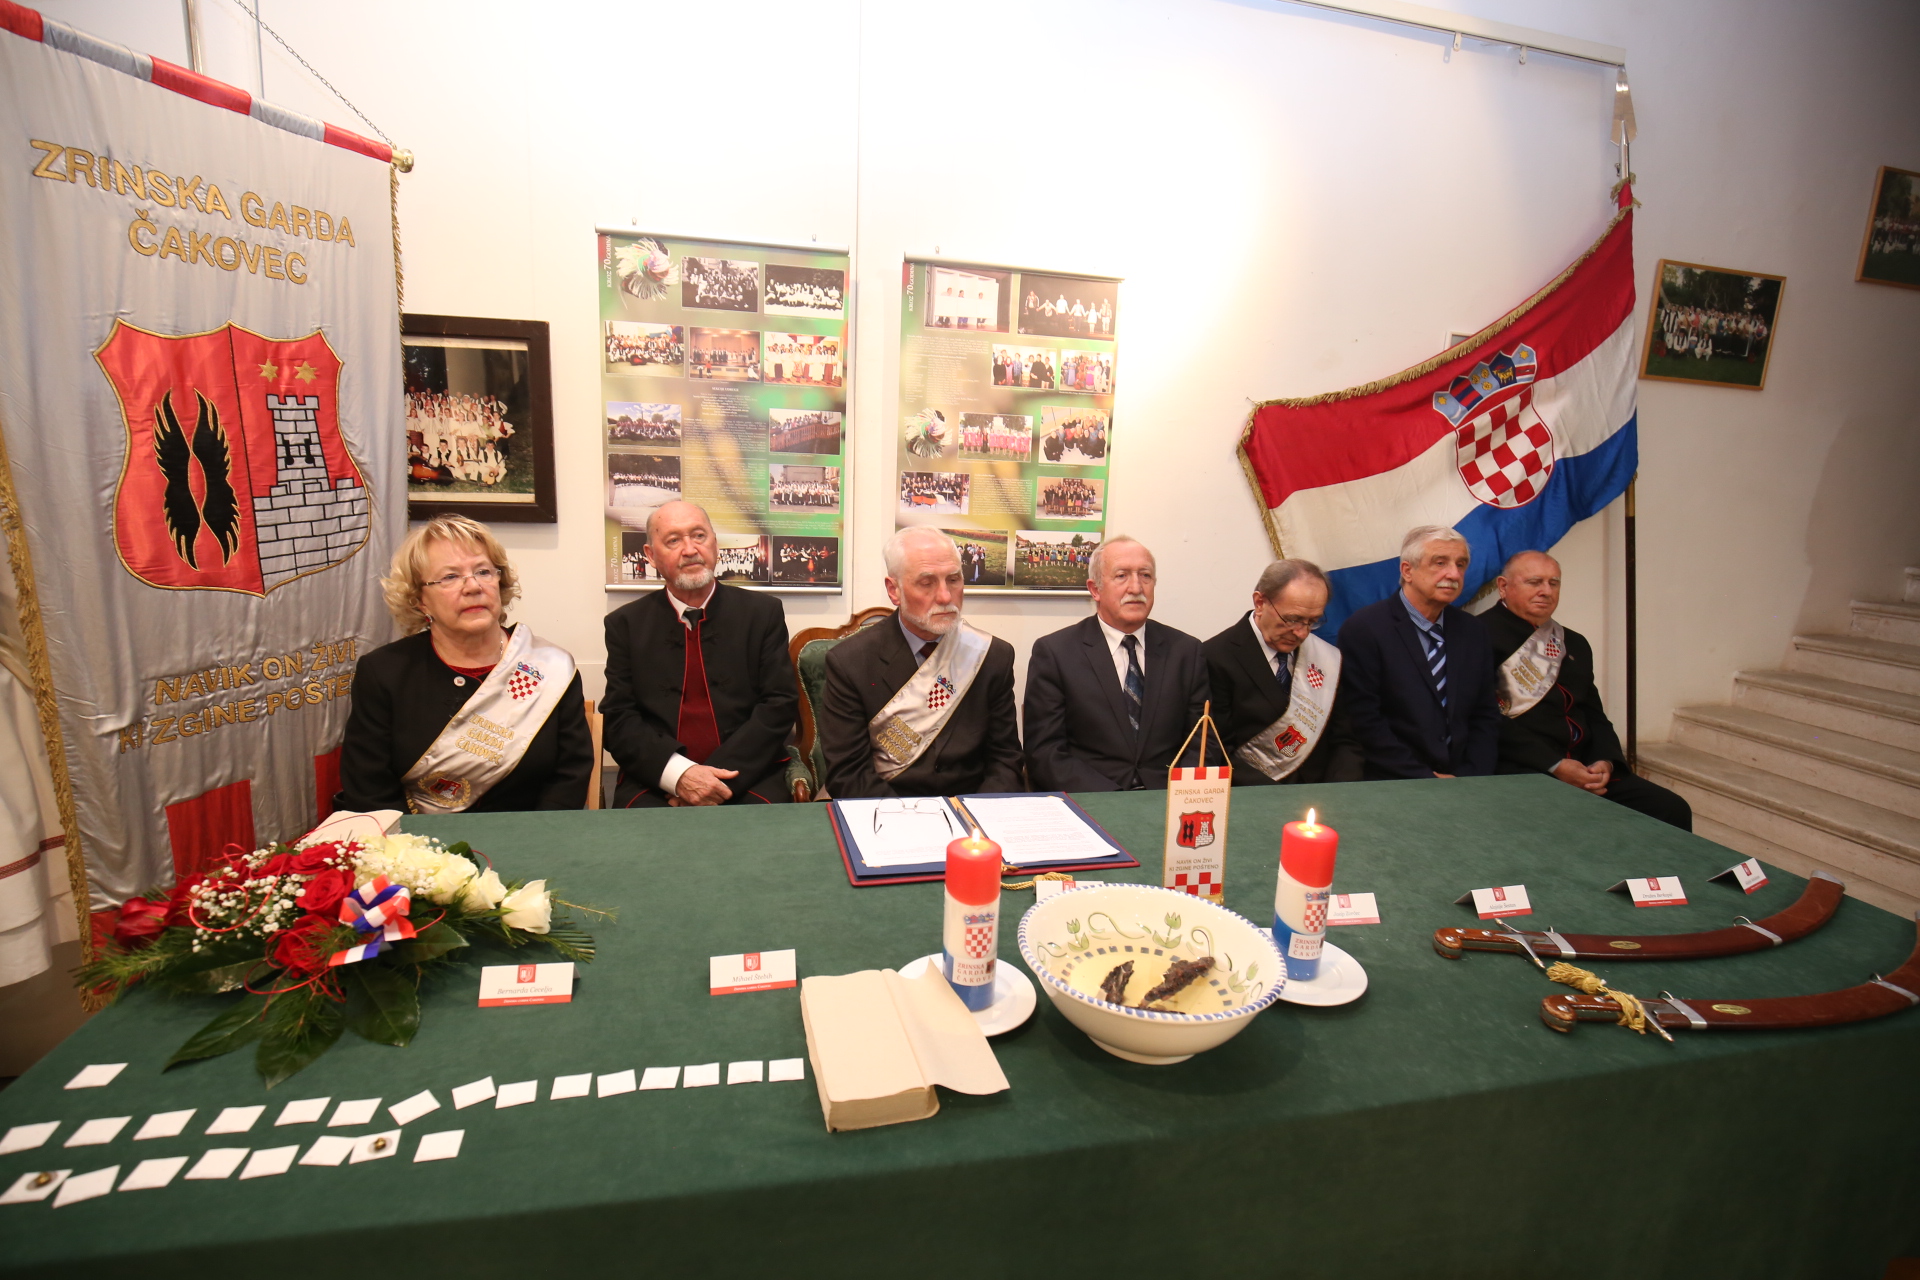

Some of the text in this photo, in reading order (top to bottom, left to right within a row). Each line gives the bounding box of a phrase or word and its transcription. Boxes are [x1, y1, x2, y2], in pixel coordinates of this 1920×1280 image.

[30, 139, 356, 247] ZRINSKA GARDA
[128, 208, 308, 284] ČAKOVEC
[604, 258, 612, 270] 70
[906, 284, 914, 295] 70
[610, 557, 619, 568] 70
[155, 640, 357, 705] NAVIK ON ŽIVI
[119, 672, 356, 754] KI ZGINE POŠTE
[469, 713, 515, 741] ZRINSKA
[466, 727, 505, 751] GARDA
[957, 962, 985, 970] ZRINSKA
[957, 968, 984, 976] GARDA
[496, 986, 529, 995] Bernarda
